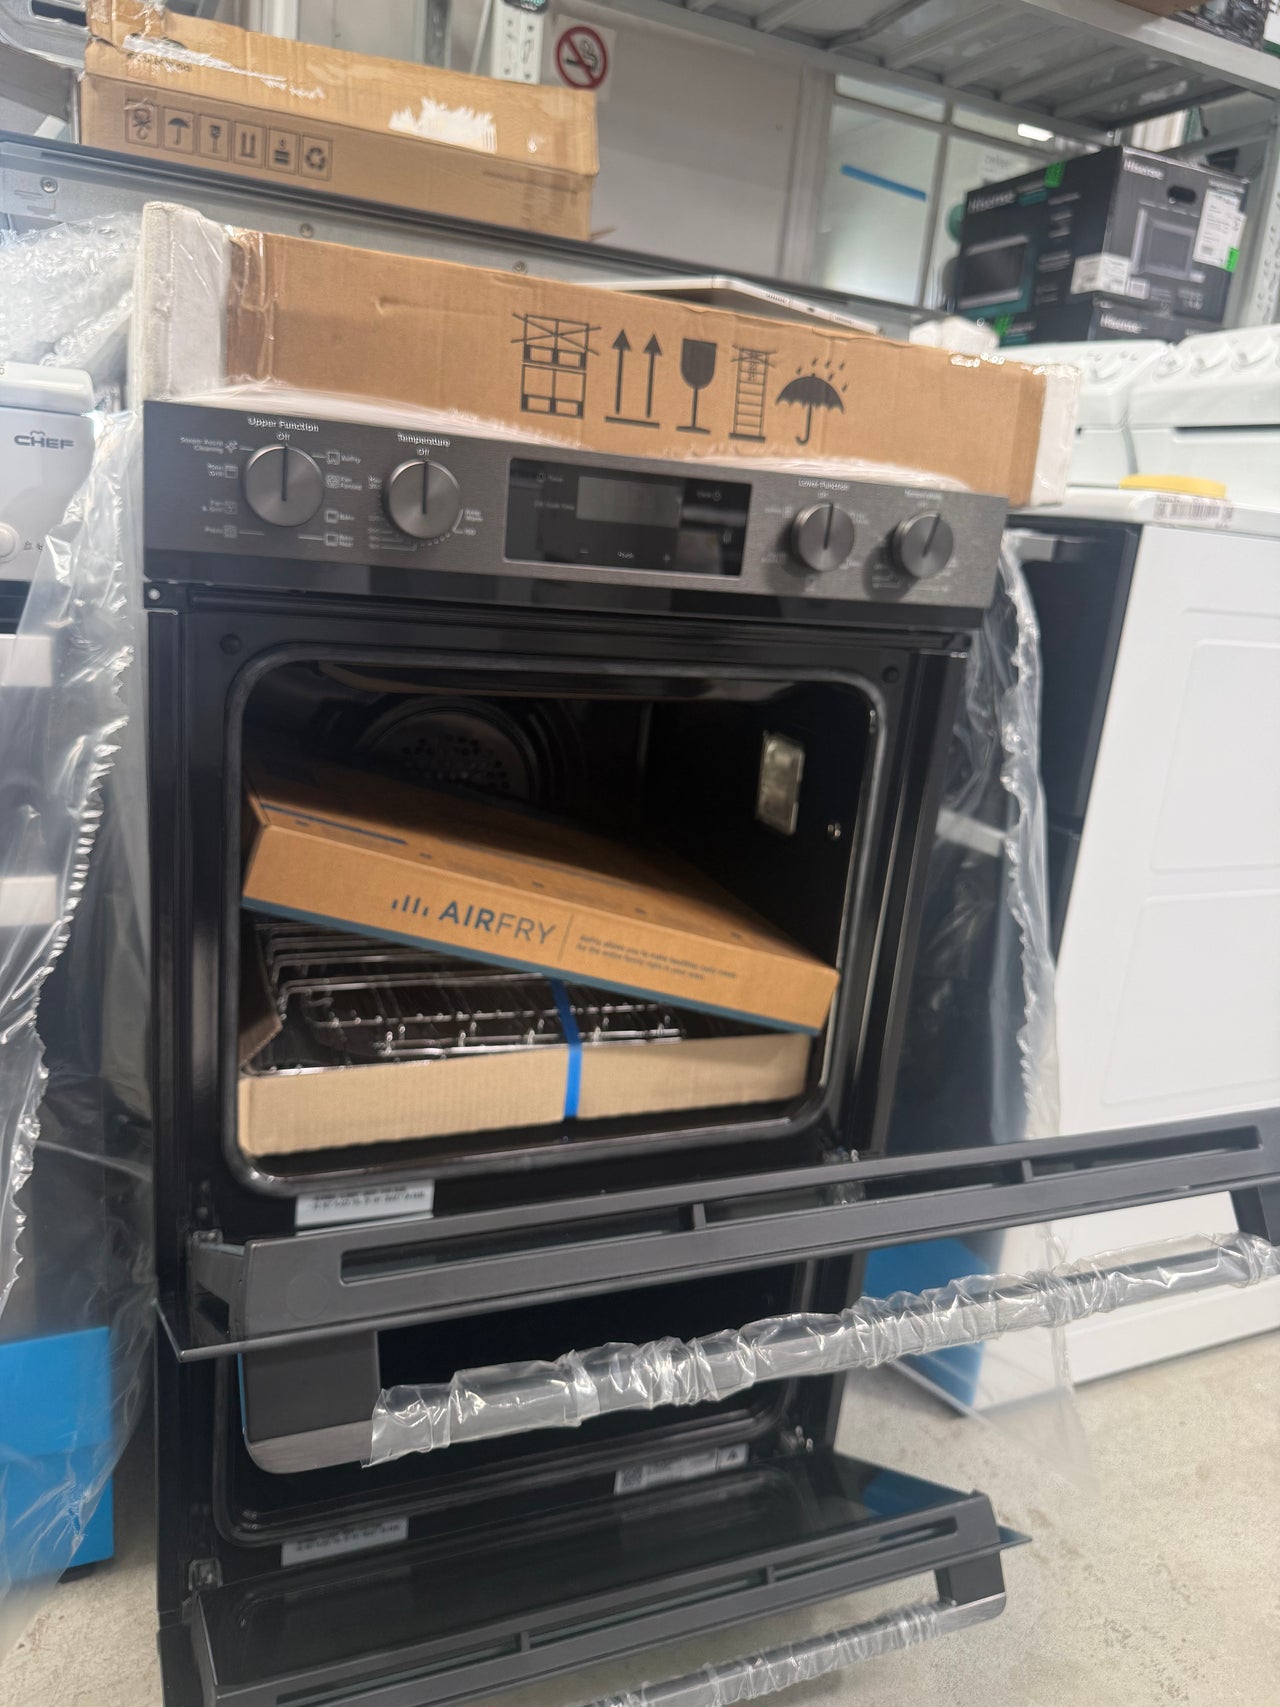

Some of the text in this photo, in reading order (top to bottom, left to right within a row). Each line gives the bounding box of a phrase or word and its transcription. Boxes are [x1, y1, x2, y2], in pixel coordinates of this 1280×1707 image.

[1124, 160, 1163, 180] Hisense
[1100, 315, 1142, 335] Hisense
[248, 416, 319, 432] Upper Function
[14, 434, 74, 449] CHEF
[276, 432, 291, 441] Off
[397, 432, 451, 447] Temperature
[438, 901, 557, 945] AIRFRY
